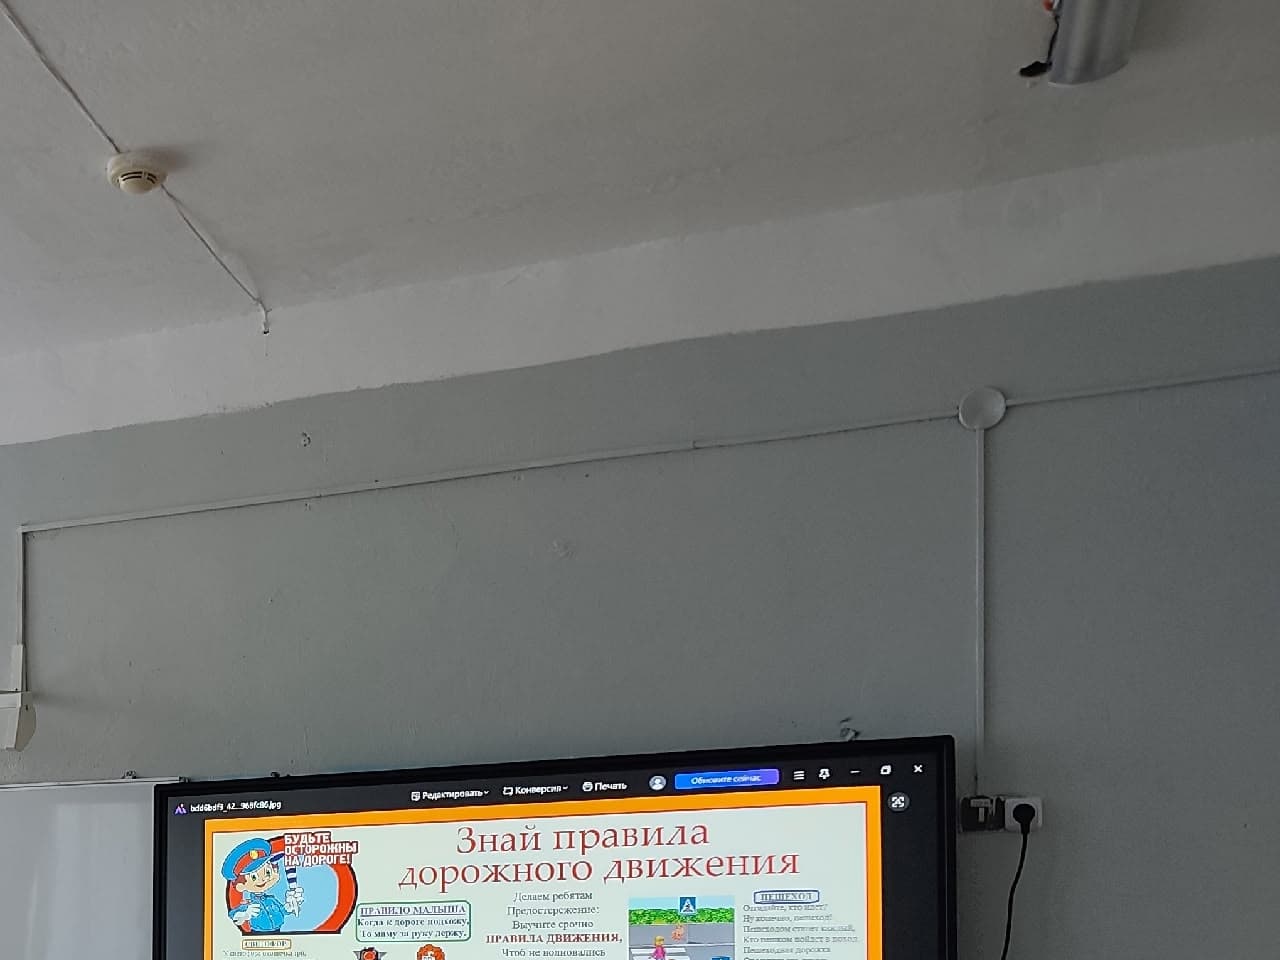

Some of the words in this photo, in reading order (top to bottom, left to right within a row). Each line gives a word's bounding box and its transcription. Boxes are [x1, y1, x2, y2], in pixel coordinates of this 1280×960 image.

[595, 782, 627, 791] Печать
[423, 790, 483, 800] Редактировать
[284, 833, 331, 844] БУДЬТЕ
[457, 824, 541, 853] Знай
[553, 824, 710, 855] правила
[284, 842, 358, 855] ОСТОРОЖНЫ
[284, 856, 299, 866] НА
[303, 854, 351, 866] ДОРОГЕ!
[398, 860, 592, 894] дорожного
[604, 854, 800, 884] движения
[514, 893, 550, 902] Делаем
[553, 892, 592, 902] ребятам
[361, 907, 410, 915] ПРАВИЛО
[413, 905, 465, 914] МАЛЫША
[358, 919, 383, 927] Когда
[512, 921, 555, 931] Выучите
[559, 922, 593, 930] срочно
[374, 931, 397, 939] маму
[412, 931, 433, 939] руку
[486, 935, 543, 943] ПРАВИЛА
[546, 934, 622, 944] ДВИЖЕНИЯ,
